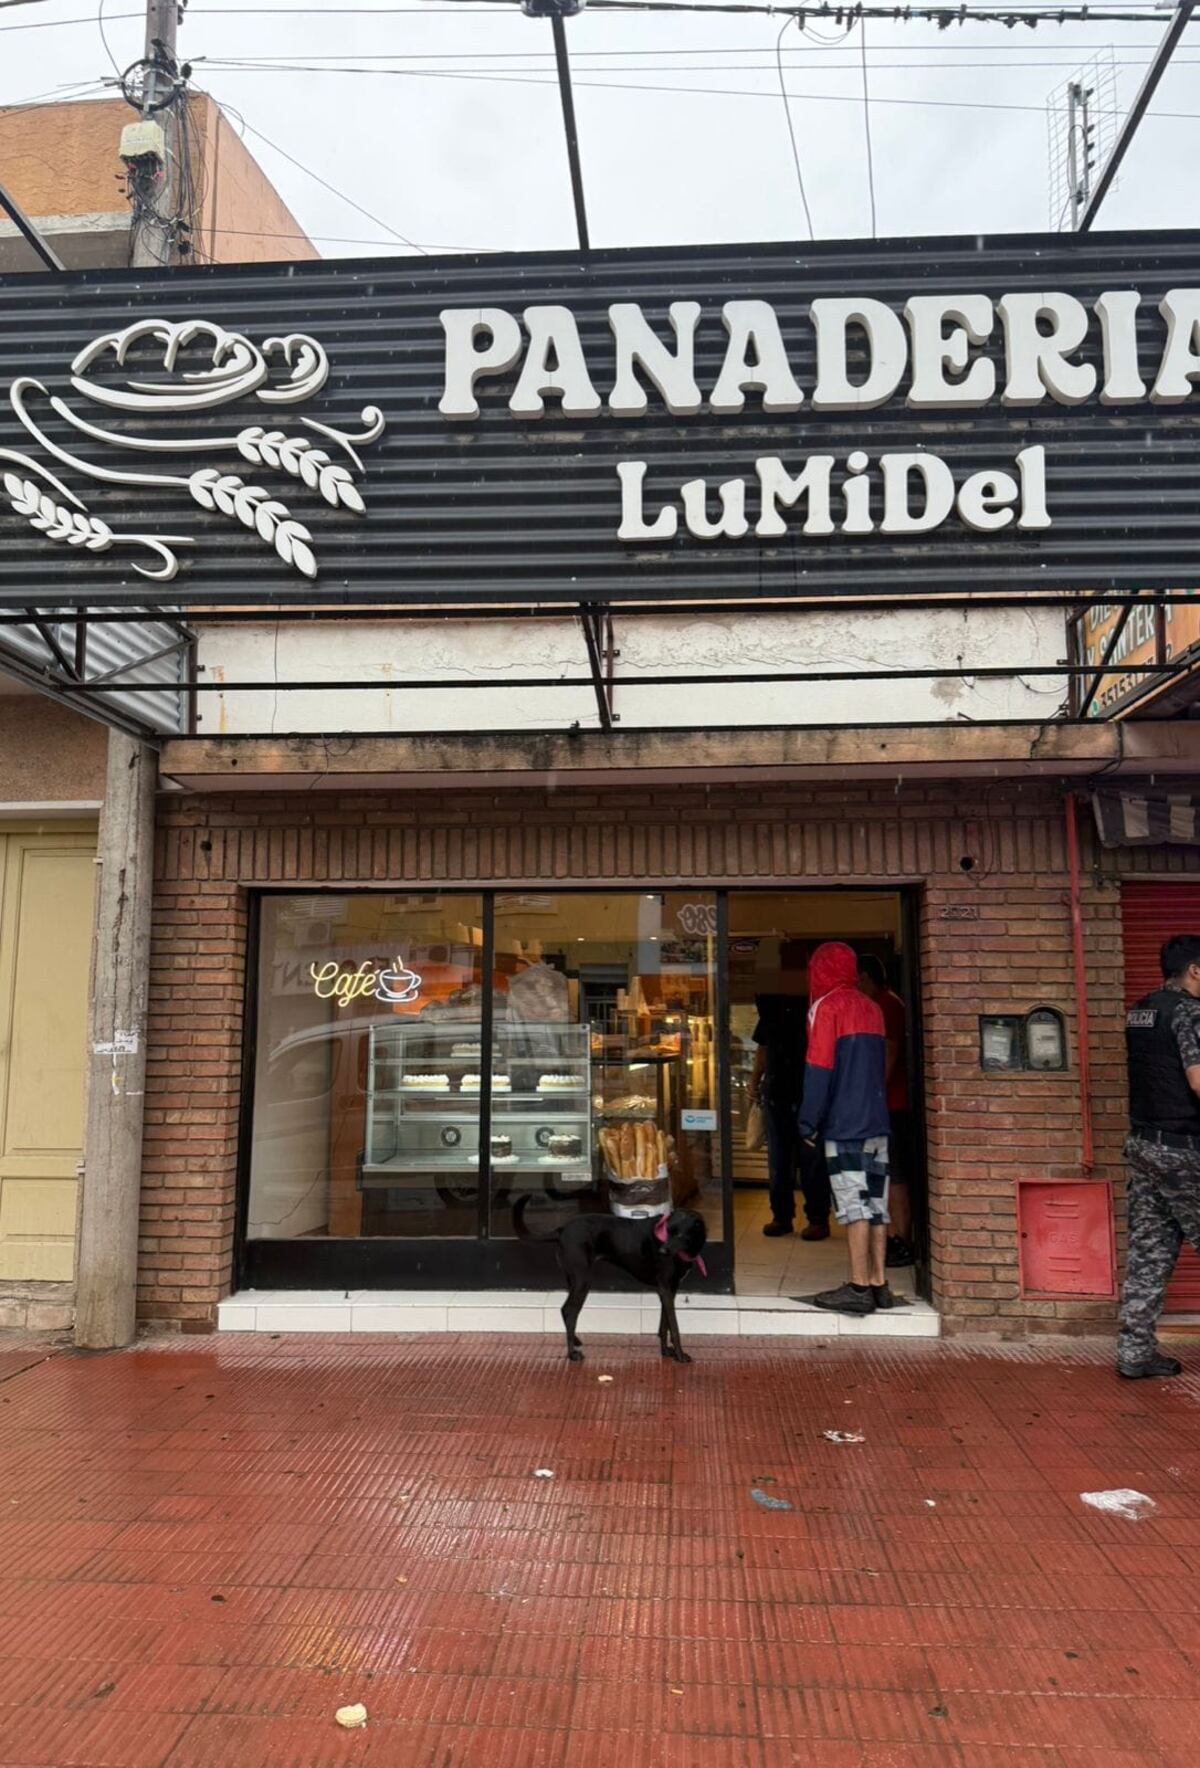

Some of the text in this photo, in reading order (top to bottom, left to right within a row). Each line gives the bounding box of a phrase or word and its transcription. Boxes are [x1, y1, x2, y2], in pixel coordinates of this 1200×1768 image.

[438, 289, 1200, 420] PANADERIA
[616, 445, 1052, 541] LuMiDel
[310, 961, 380, 1007] Café
